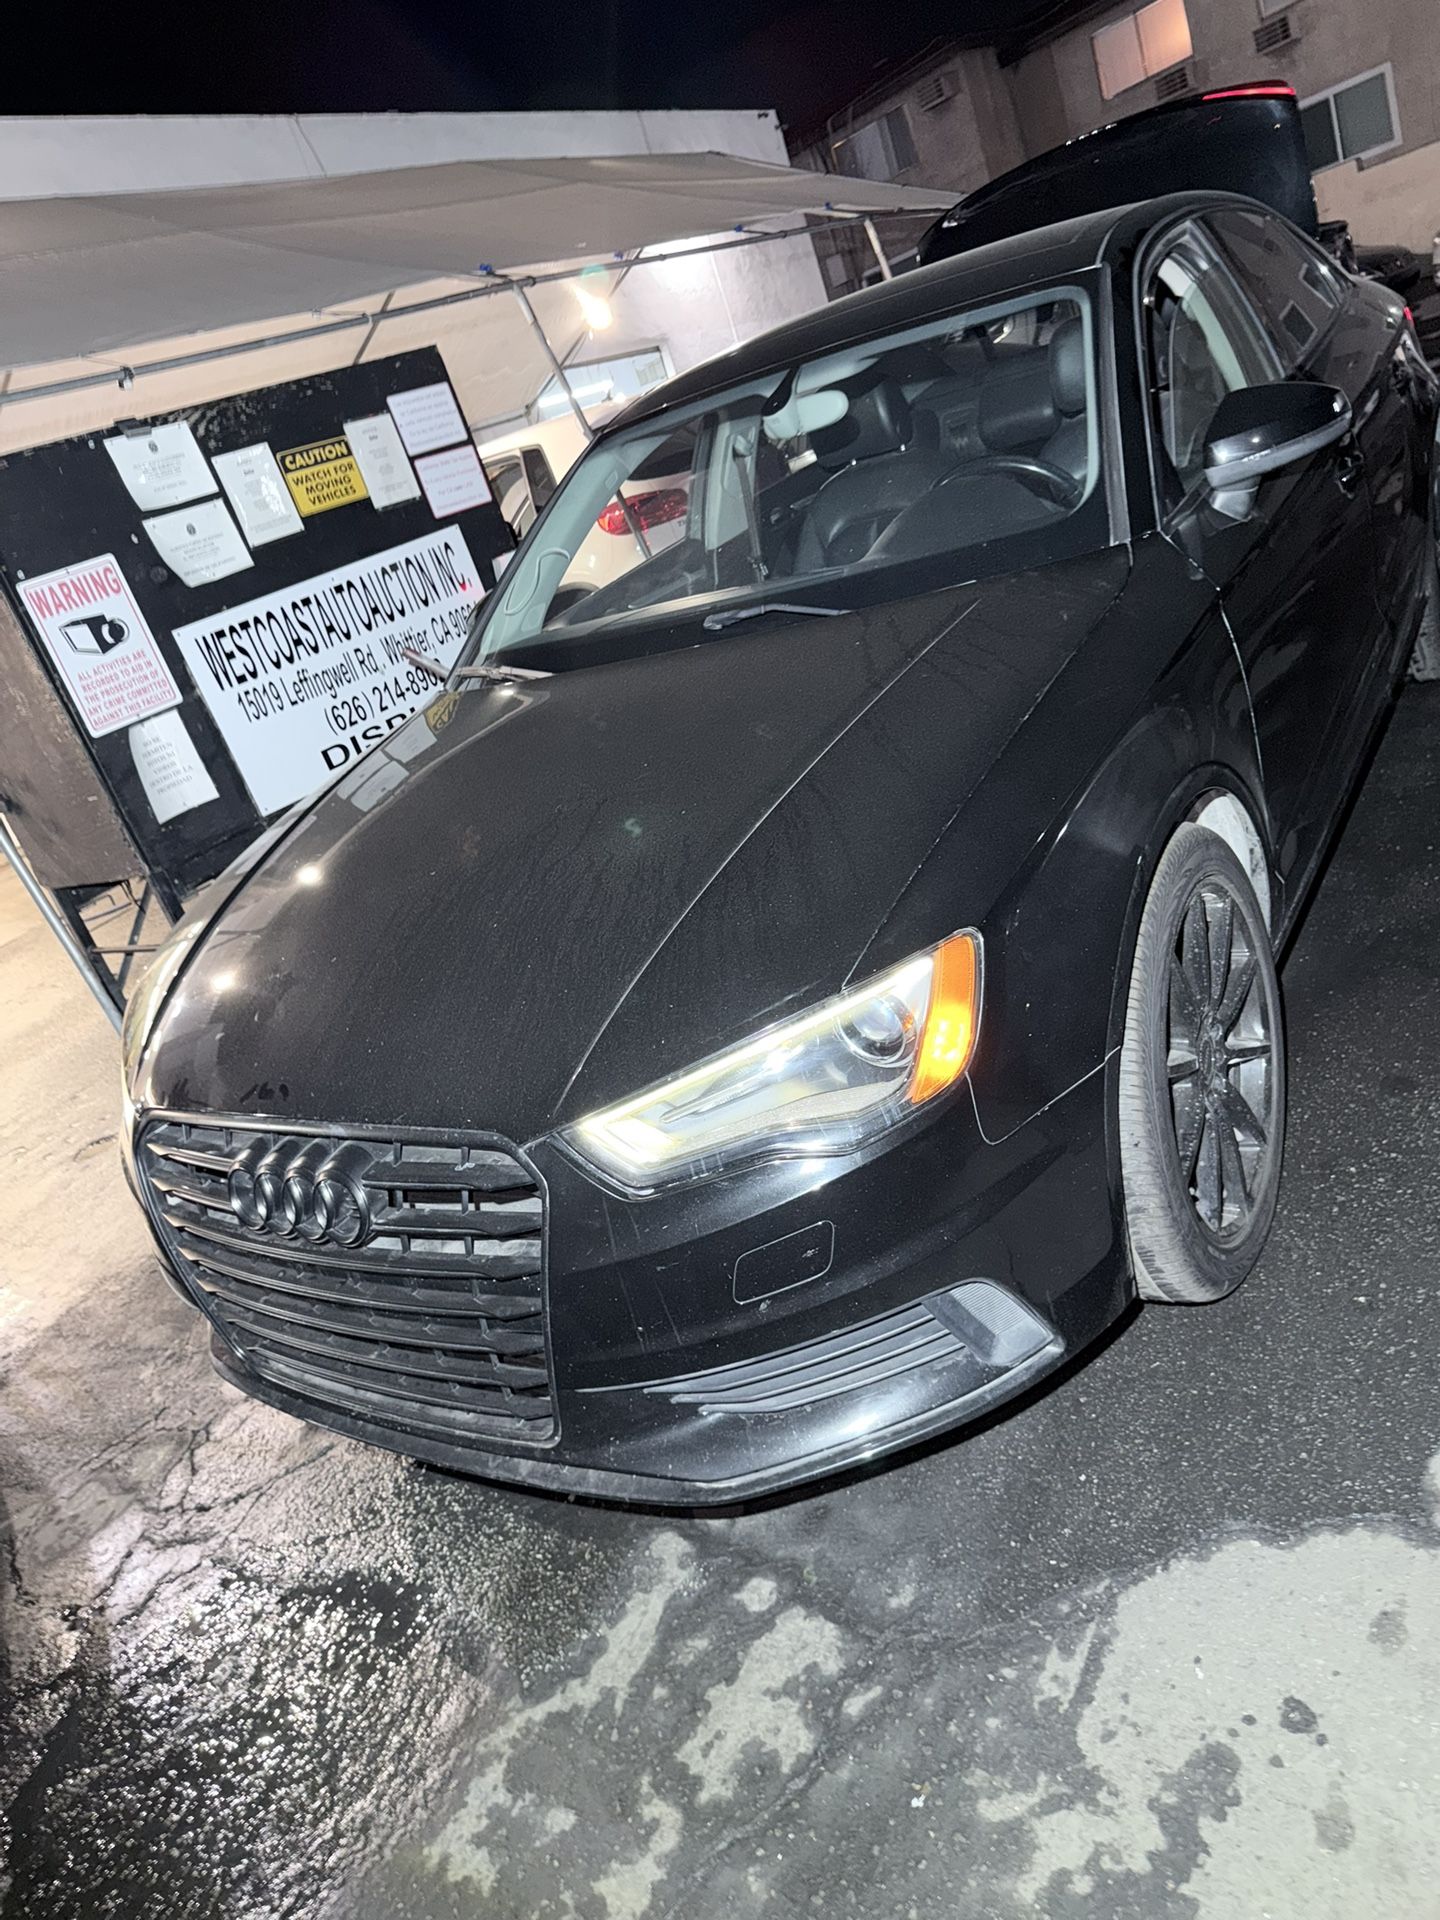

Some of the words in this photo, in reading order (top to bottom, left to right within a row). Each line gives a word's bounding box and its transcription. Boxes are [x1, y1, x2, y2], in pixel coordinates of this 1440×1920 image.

[285, 441, 348, 470] CAUTION
[292, 467, 332, 487] WATCH
[333, 462, 355, 475] FOR
[305, 474, 352, 496] MOVING
[309, 484, 357, 507] VEHICLES
[28, 566, 122, 620] WARNING
[194, 551, 441, 691] WESTCOASTAUTOAUCTION
[427, 541, 473, 599] INC.
[77, 671, 92, 682] ALL
[93, 655, 132, 676] ACTIVITIES
[132, 649, 147, 661] ARE
[81, 671, 120, 693] RECORDED
[120, 667, 131, 678] TO
[131, 662, 144, 673] AID
[144, 659, 153, 669] IN
[237, 681, 284, 723] 15019
[279, 651, 360, 707] Leffingwell
[430, 614, 455, 645] CA
[84, 693, 100, 705] THE
[100, 673, 150, 699] PROSECUTION
[149, 668, 159, 680] OF
[87, 703, 103, 717] ANY
[103, 694, 126, 708] CRIME
[126, 679, 168, 701] COMMITTED
[324, 691, 375, 736] (626)
[371, 657, 447, 713] 214-89
[93, 708, 124, 727] AGAINST
[124, 701, 143, 715] THIS
[142, 688, 173, 708] FACILITY
